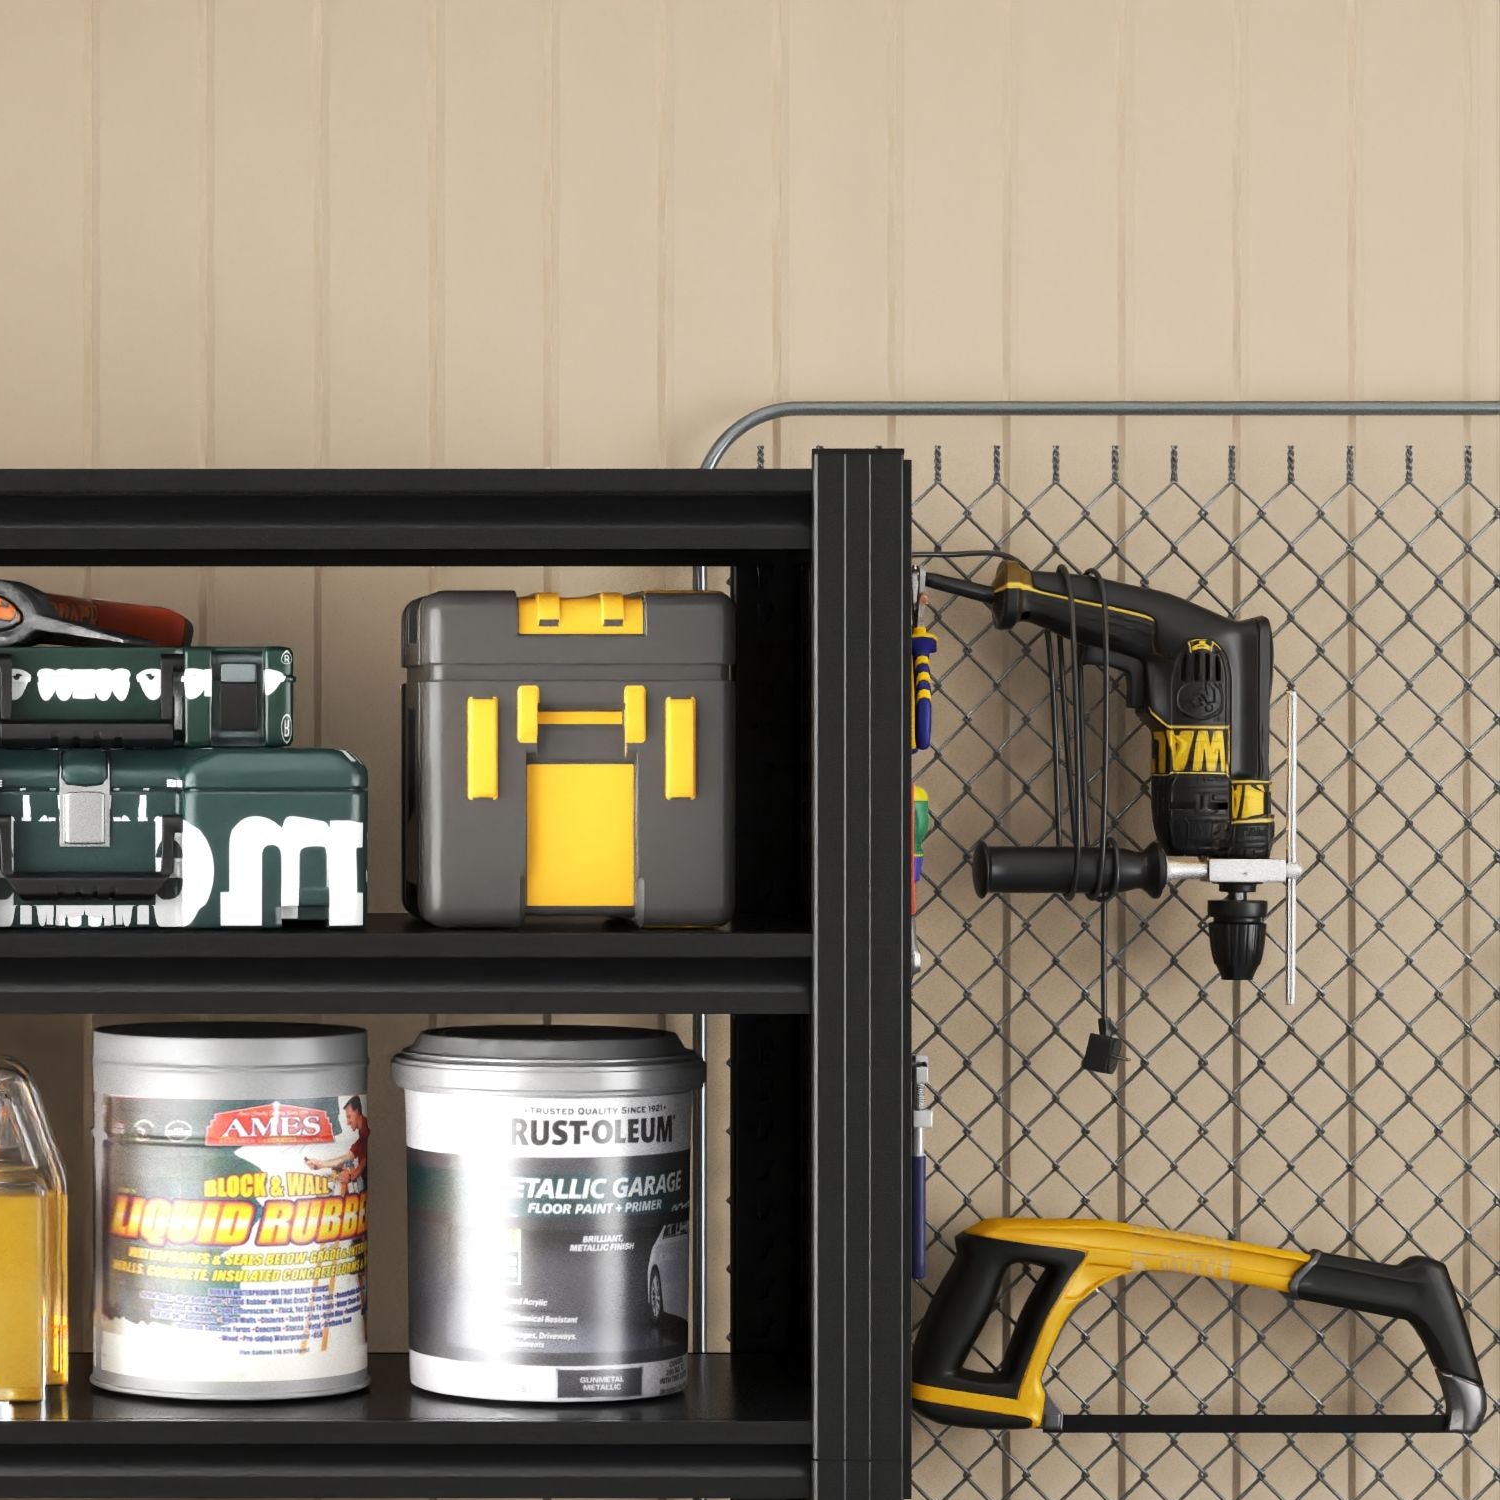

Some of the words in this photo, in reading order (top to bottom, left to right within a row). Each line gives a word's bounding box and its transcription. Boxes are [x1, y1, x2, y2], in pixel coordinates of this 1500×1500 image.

[530, 1107, 574, 1115] TRUSTED
[578, 1107, 618, 1115] QUALITY
[621, 1106, 646, 1114] SINCE
[648, 1104, 663, 1113] 1921
[219, 1115, 321, 1138] AMES
[512, 1115, 673, 1146] RUST-OLEUM
[203, 1172, 267, 1198] BLOCK
[270, 1175, 284, 1197] &
[286, 1172, 330, 1197] WALL
[514, 1176, 608, 1200] ETALLIC
[612, 1170, 683, 1198] GARAGE
[528, 1202, 571, 1215] FLOOR
[574, 1202, 614, 1215] PAINT
[615, 1204, 623, 1213] +
[624, 1199, 663, 1213] PRIMER
[109, 1194, 256, 1248] LIQUID
[569, 1243, 608, 1251] METALLIC
[610, 1242, 635, 1250] FINISH
[212, 1254, 221, 1266] &
[224, 1252, 263, 1266] SEALS
[211, 1268, 281, 1282] INSULATED
[282, 1262, 337, 1281] CONCRETE
[580, 1376, 625, 1384] GUNMETAL
[583, 1383, 622, 1391] METALLIC
